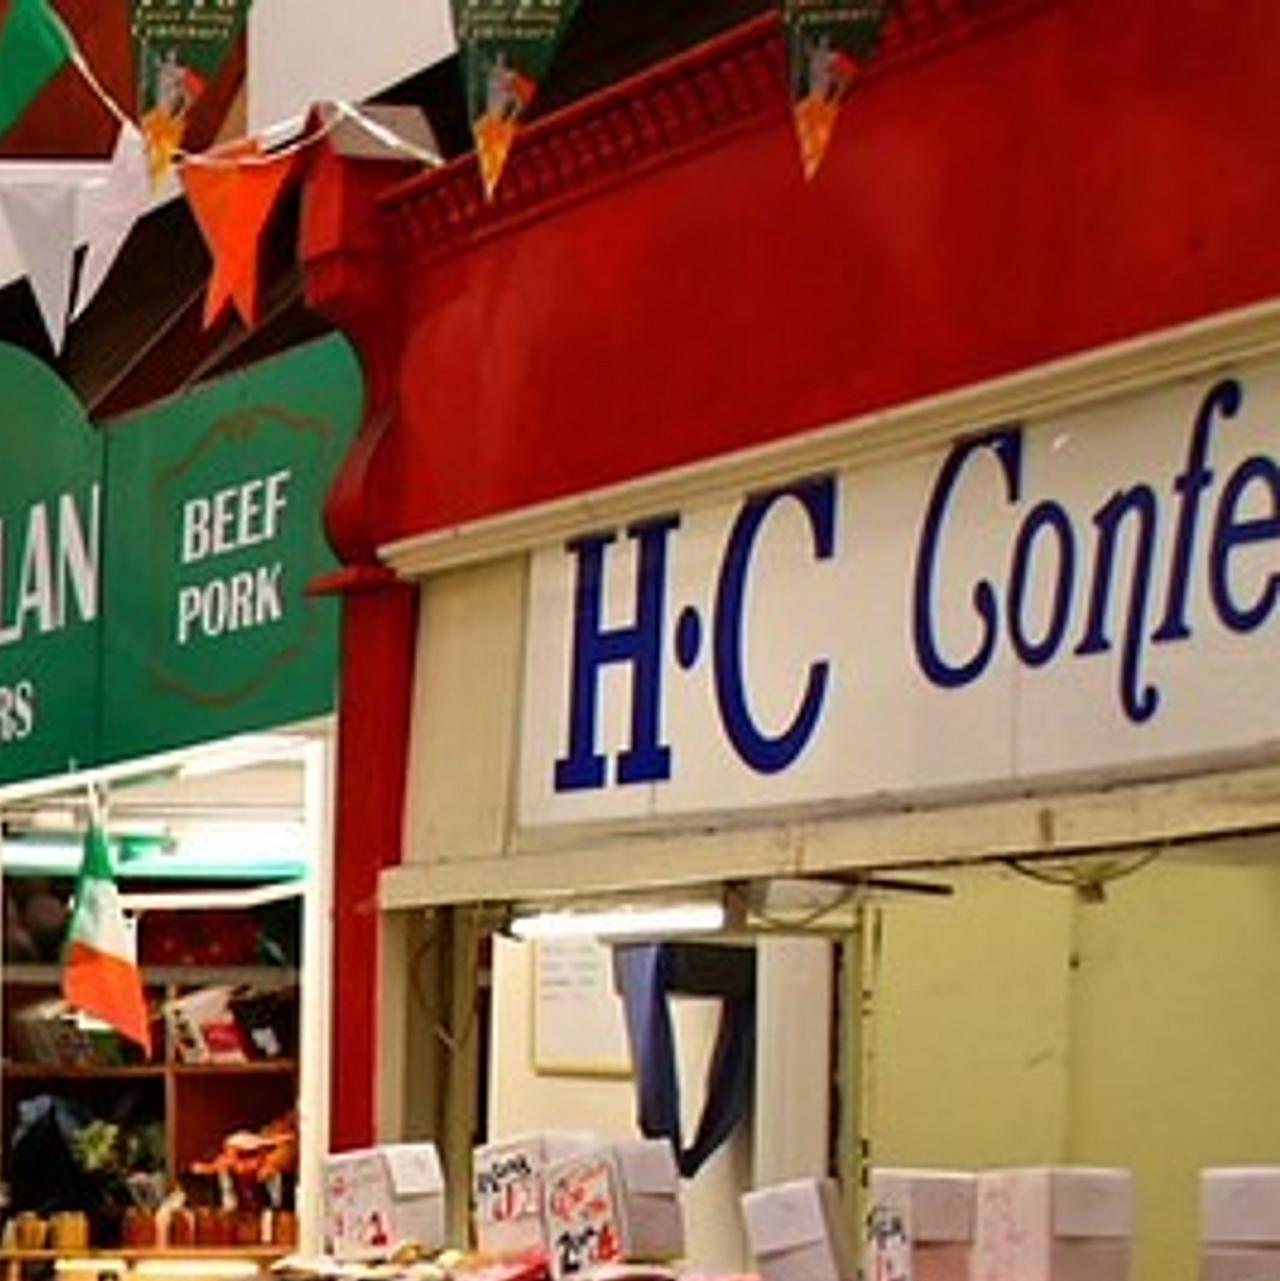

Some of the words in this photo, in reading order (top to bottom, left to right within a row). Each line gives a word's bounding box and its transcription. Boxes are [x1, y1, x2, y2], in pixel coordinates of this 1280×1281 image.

[180, 470, 293, 564] BEEF
[912, 378, 1280, 725] Confe
[176, 563, 285, 645] PORK
